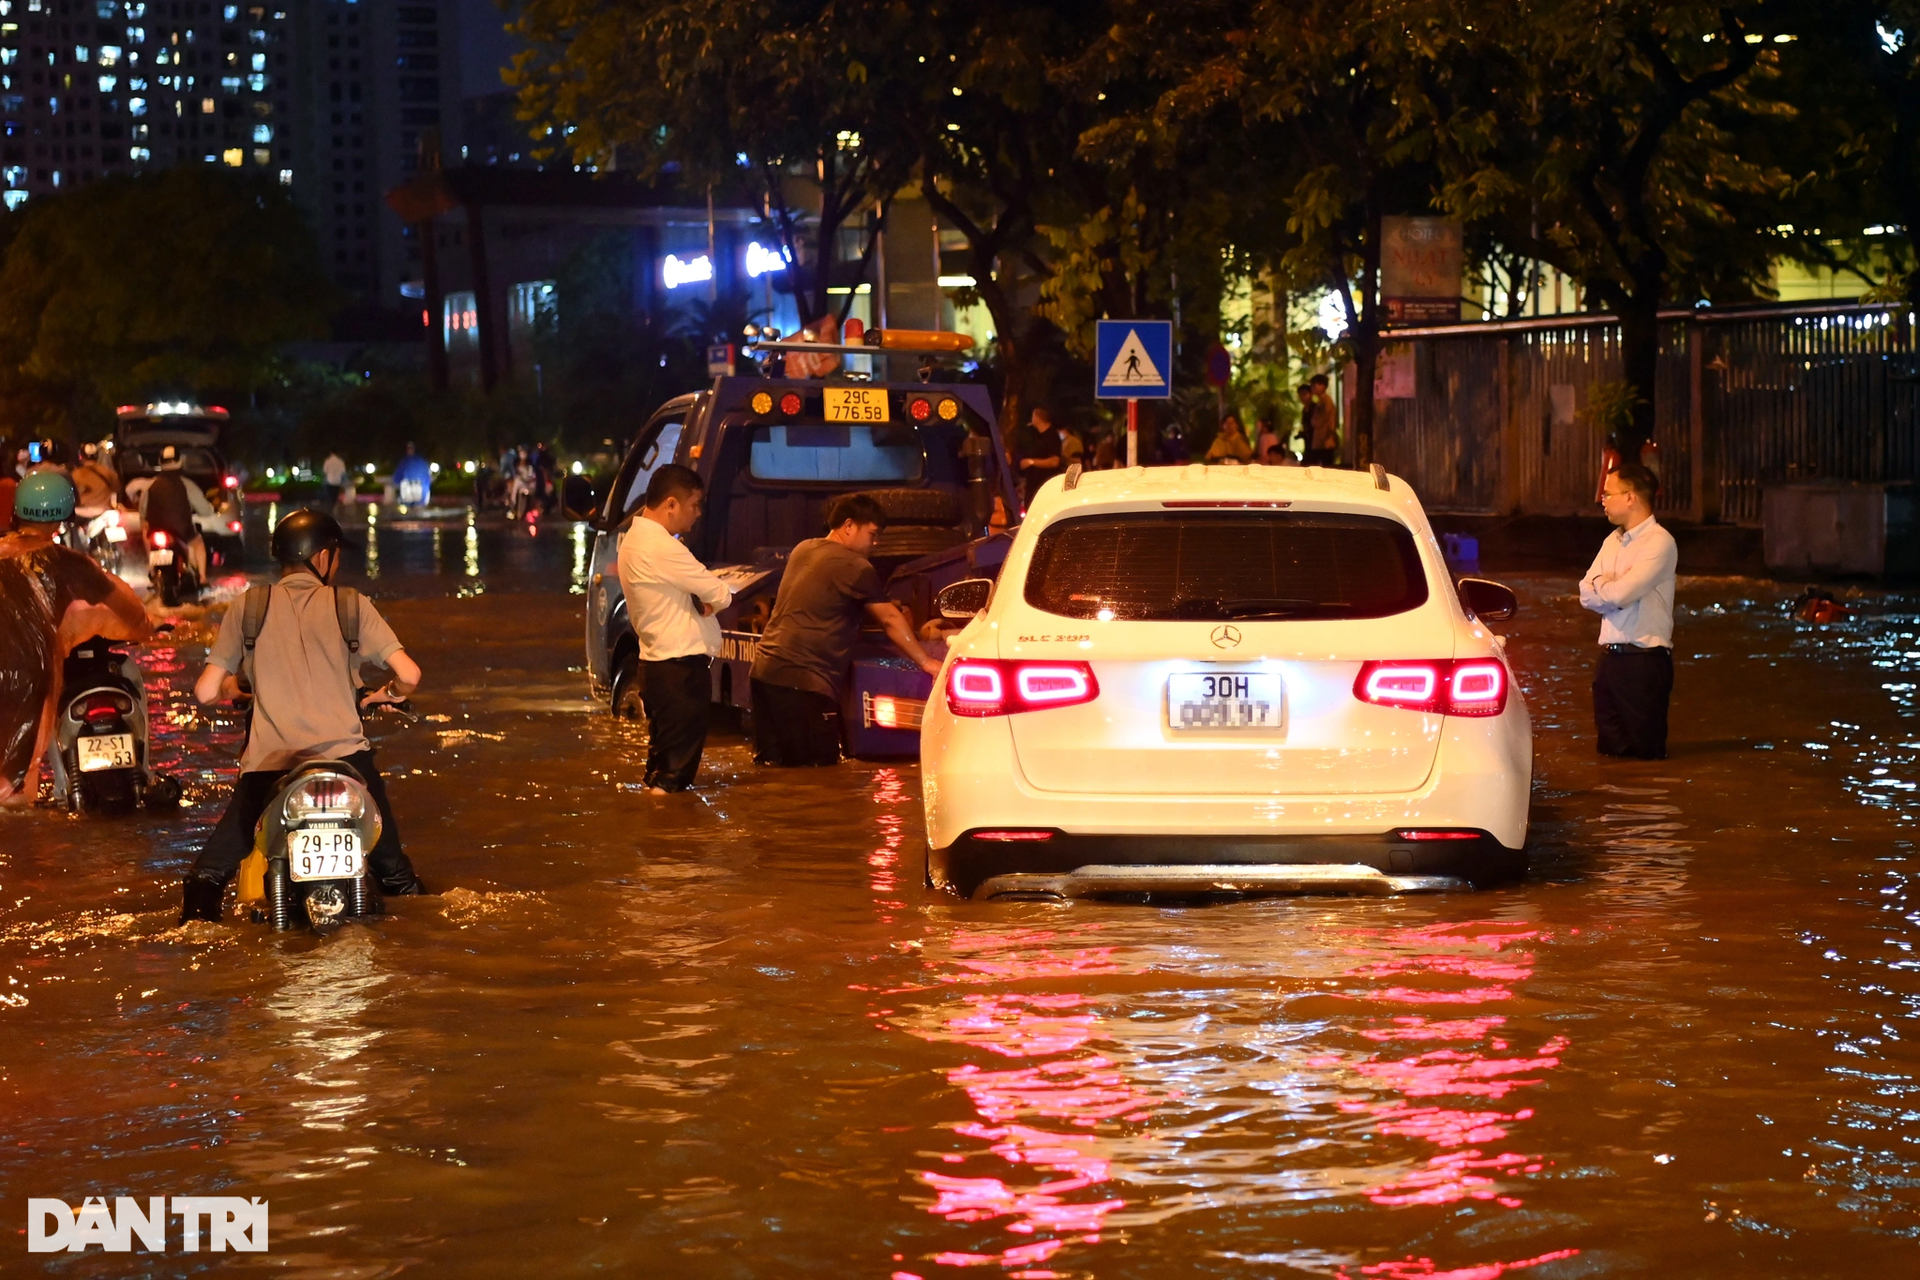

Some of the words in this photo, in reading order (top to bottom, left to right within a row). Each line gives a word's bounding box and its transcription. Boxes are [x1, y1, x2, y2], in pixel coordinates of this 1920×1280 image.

[843, 391, 870, 404] 29C
[833, 406, 882, 419] 776.58
[717, 638, 737, 660] IAO
[1202, 676, 1248, 698] 30H
[87, 736, 125, 752] 22-S1
[308, 822, 339, 830] YAMAHA
[301, 834, 353, 854] 29-P8
[302, 855, 353, 875] 9779
